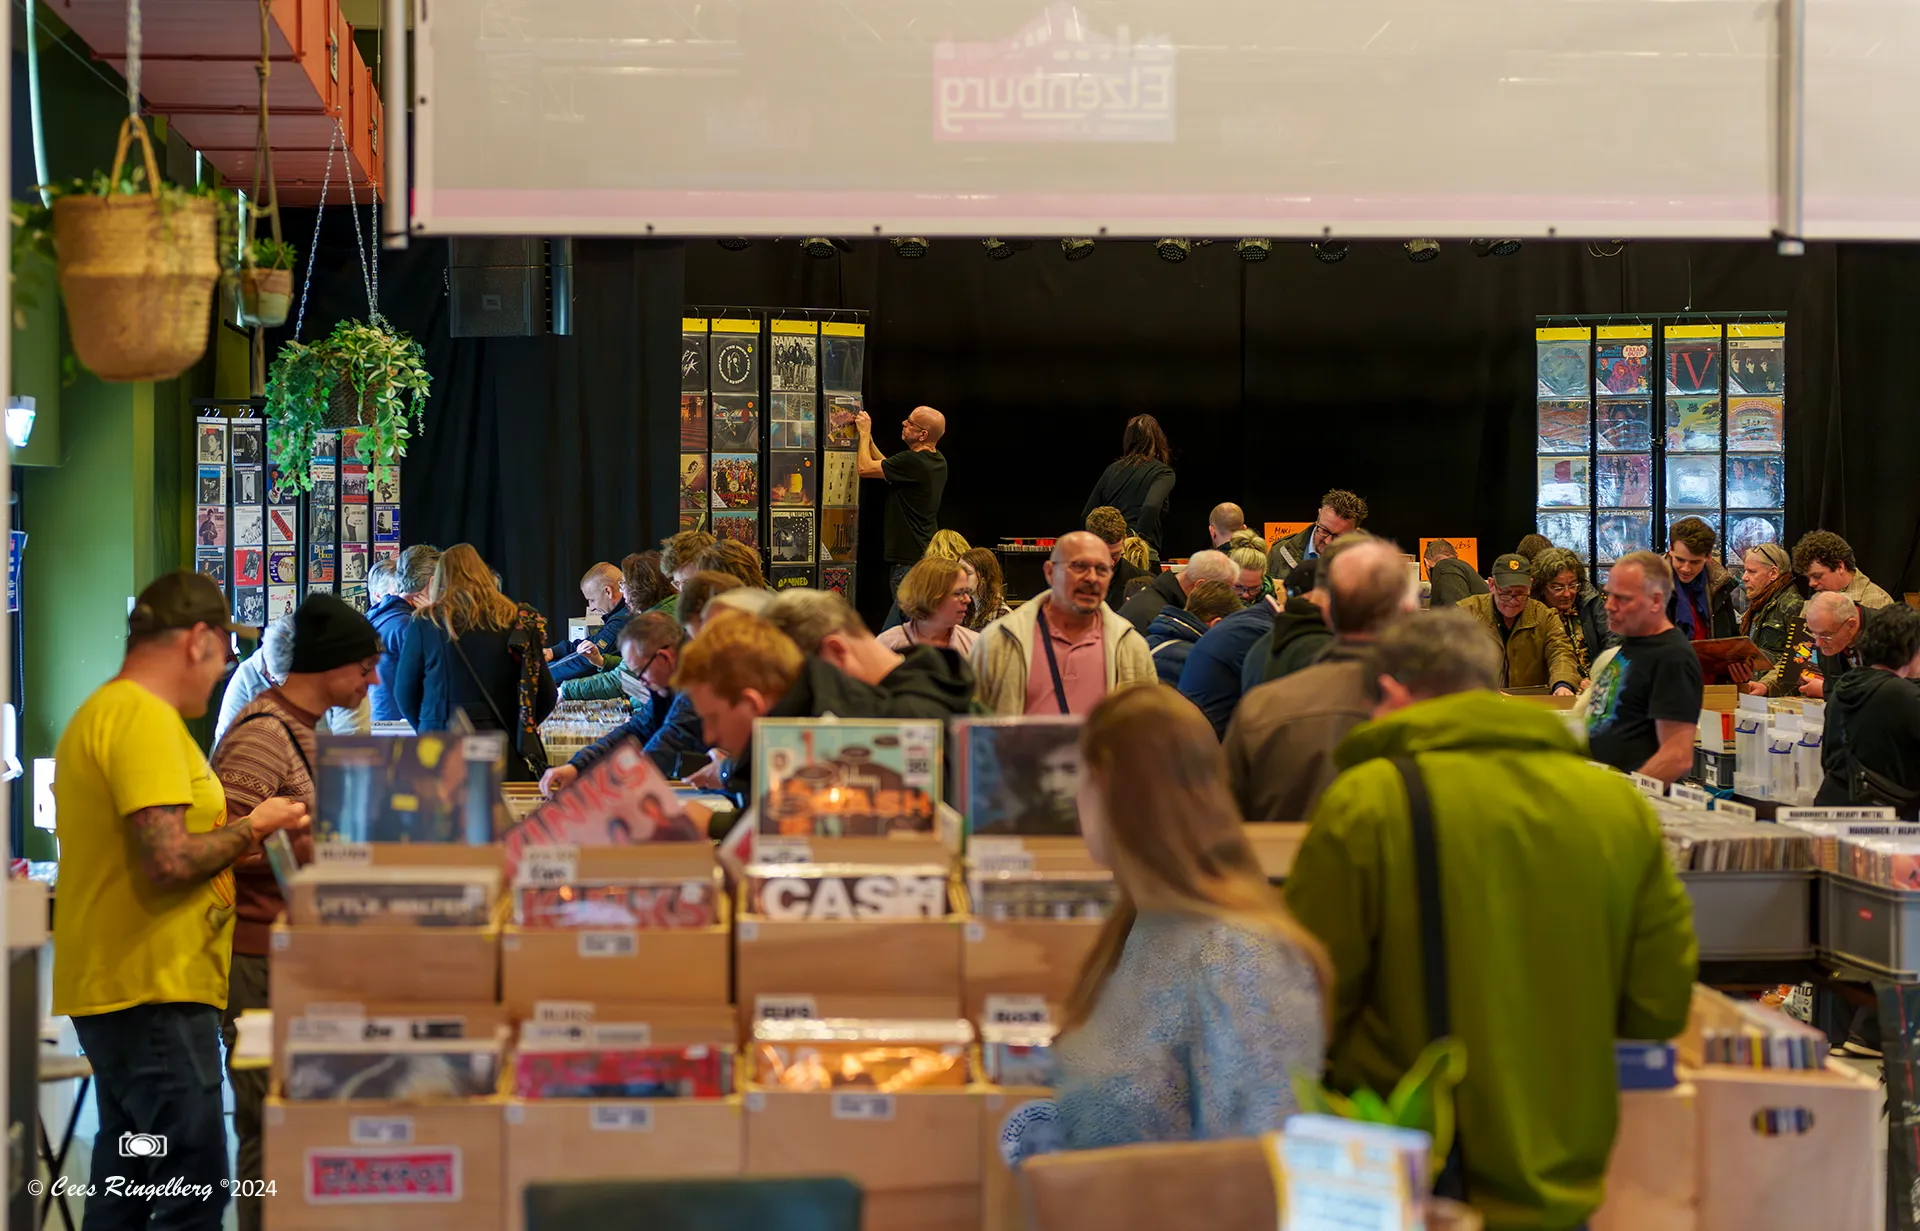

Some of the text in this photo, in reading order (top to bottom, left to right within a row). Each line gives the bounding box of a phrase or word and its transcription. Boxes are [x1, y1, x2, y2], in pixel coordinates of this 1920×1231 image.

[772, 335, 815, 346] RAMONES
[1669, 352, 1717, 390] IV
[777, 576, 809, 588] DAMNED
[763, 875, 946, 920] CASH
